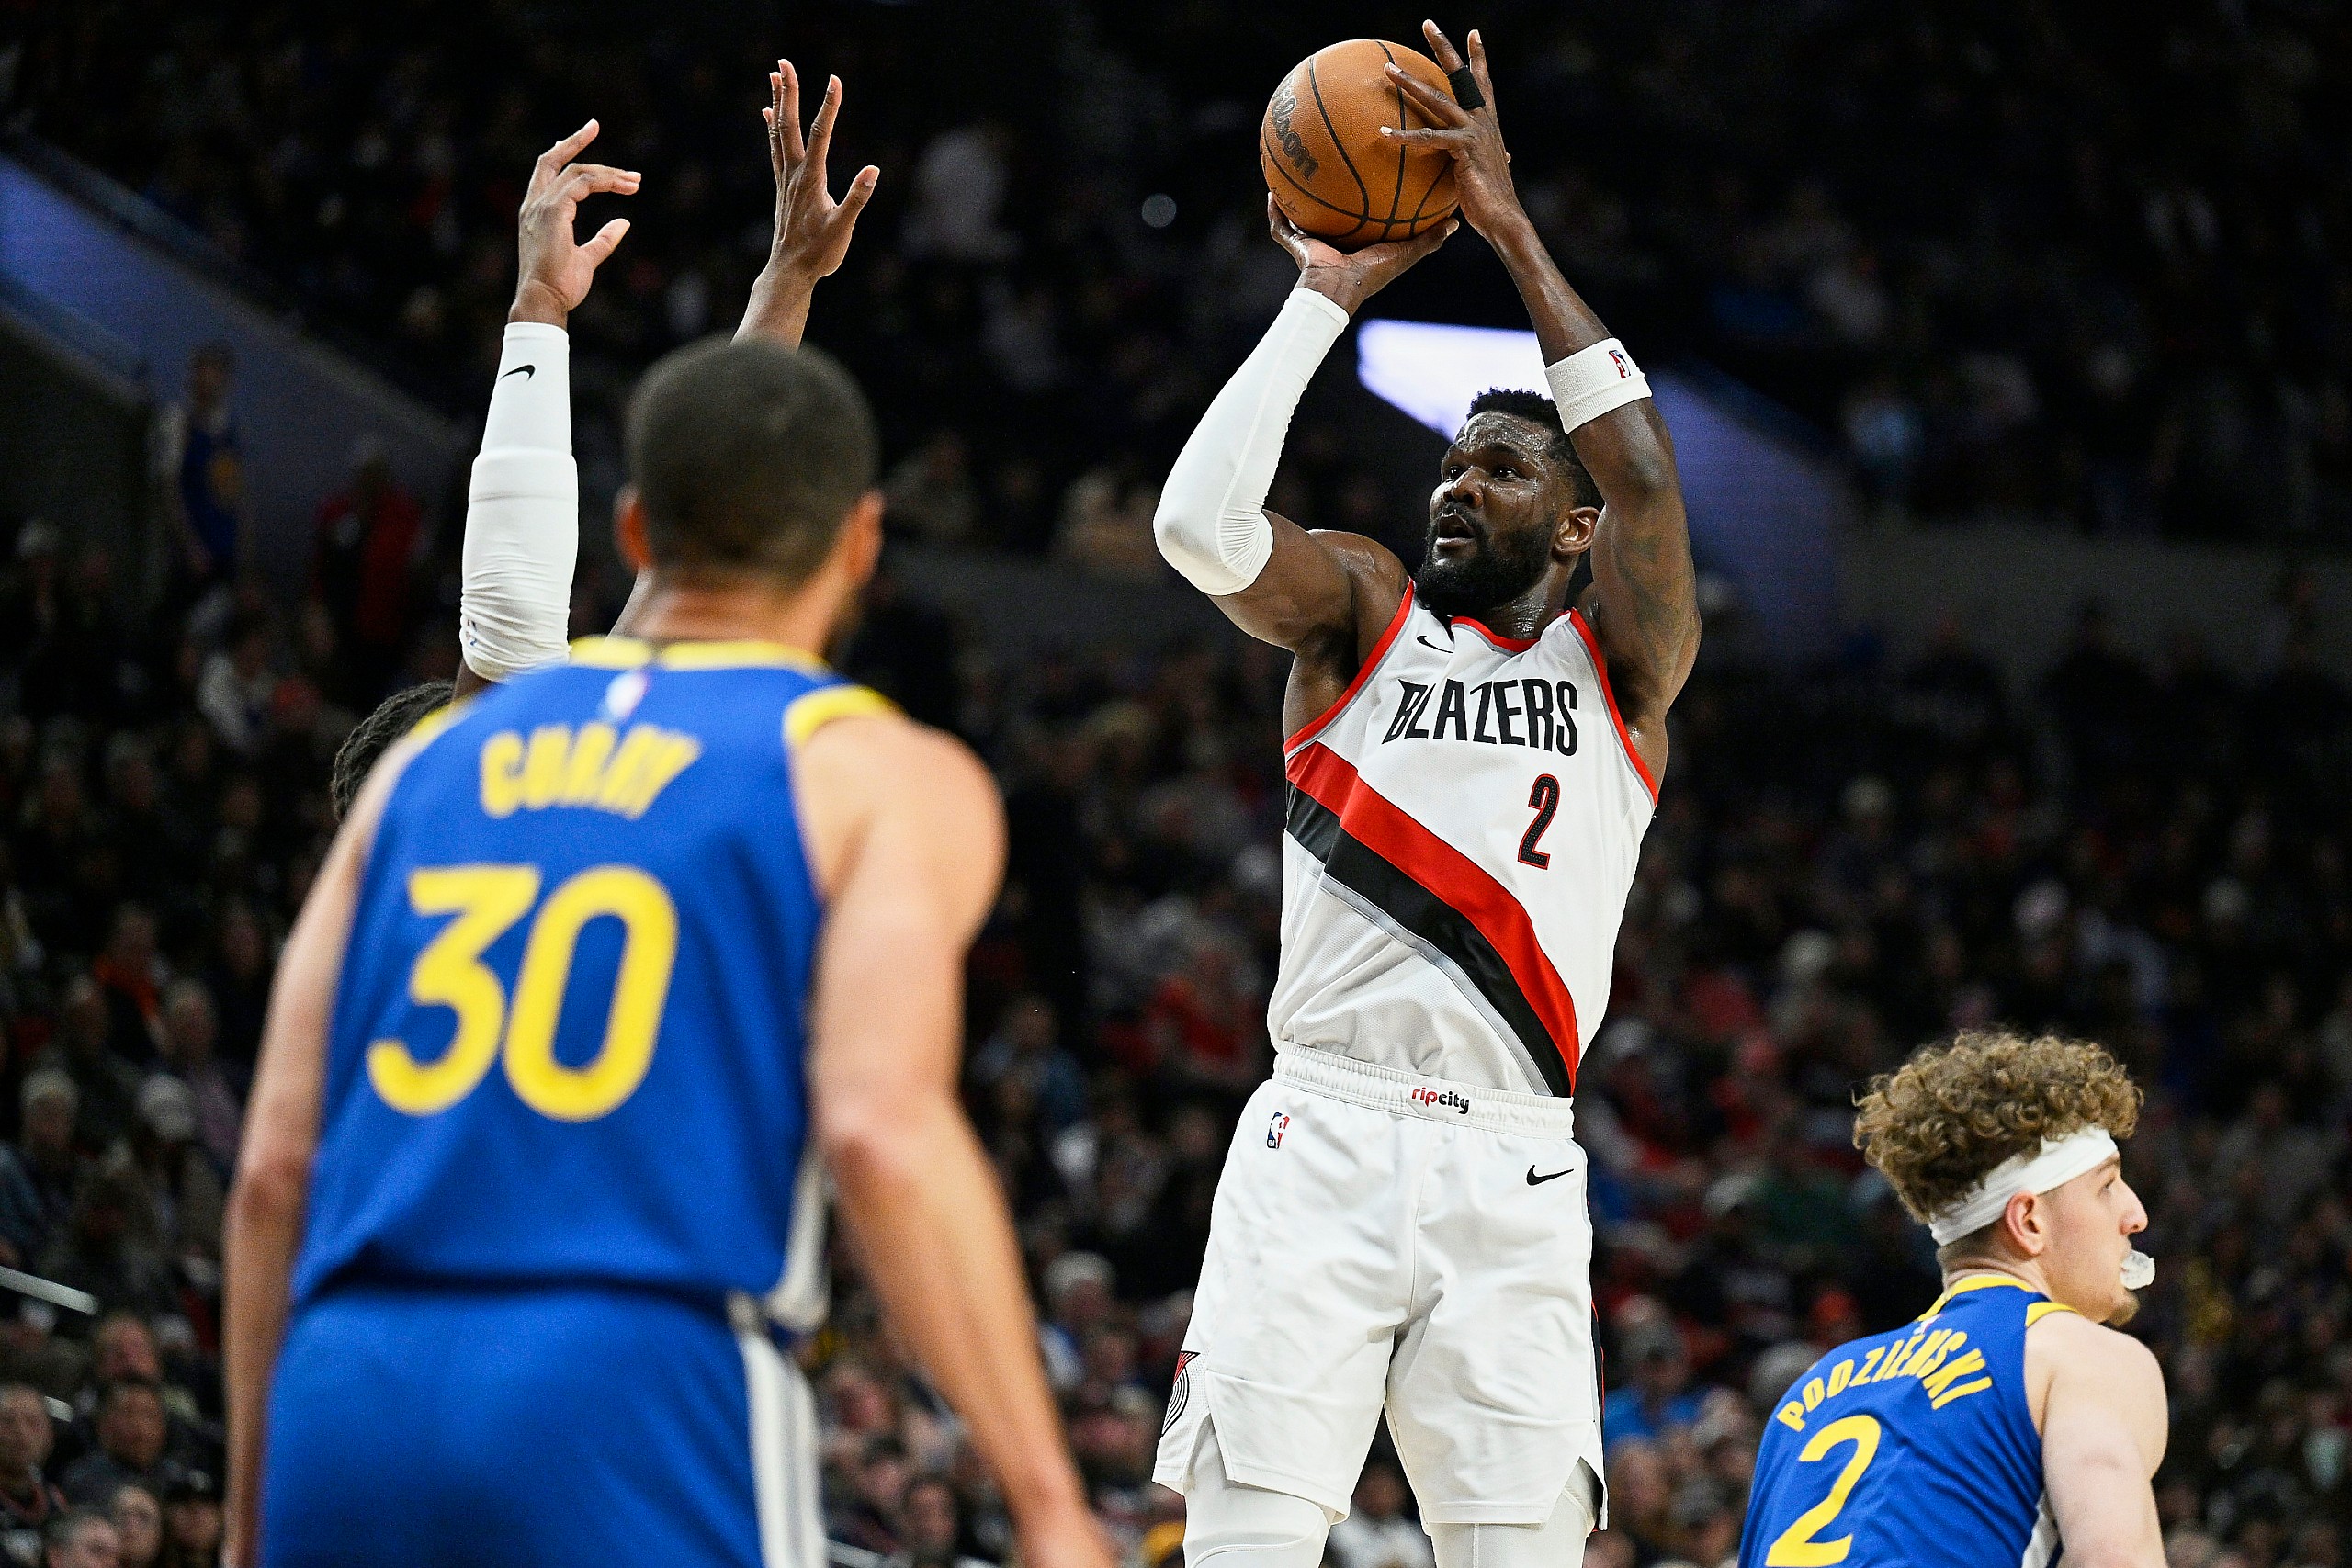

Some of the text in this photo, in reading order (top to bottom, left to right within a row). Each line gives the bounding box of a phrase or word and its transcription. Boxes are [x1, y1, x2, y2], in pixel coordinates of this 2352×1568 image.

[1381, 678, 1578, 756] BLAZERS
[1517, 773, 1561, 870] 2
[369, 865, 678, 1120] 30
[1411, 1087, 1470, 1114] ripcity
[1764, 1414, 1882, 1567] 2
